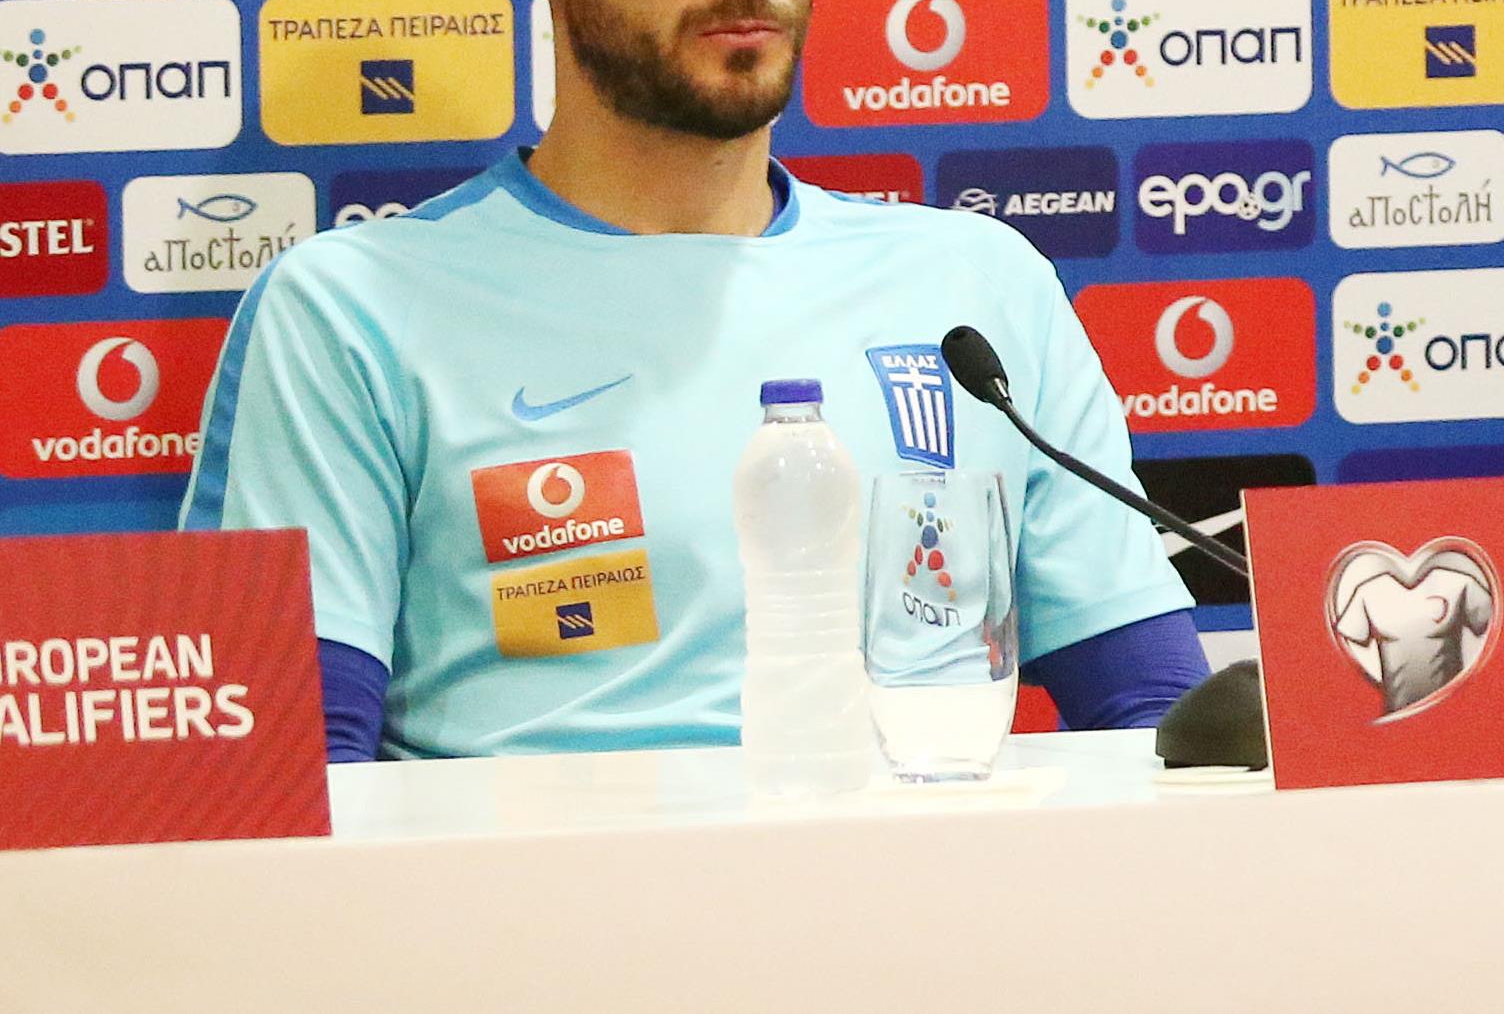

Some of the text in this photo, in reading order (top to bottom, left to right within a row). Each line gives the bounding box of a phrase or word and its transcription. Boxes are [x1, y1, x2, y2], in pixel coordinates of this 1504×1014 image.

[268, 13, 504, 41] ΤΡΑΠΕΖΑ ΠΕΙΡΑΙΩΣ
[844, 77, 1010, 111] vodafone
[1004, 191, 1116, 216] AEGEAN
[0, 219, 94, 257] STEL
[31, 426, 201, 462] vodafone
[502, 516, 625, 554] vodafone
[497, 566, 647, 601] ΤΡΑΠΕΖΑ ΠΕΙΡΑΙΩΣ
[0, 633, 215, 685] ROPEAN
[0, 684, 255, 746] ALIFIERS
